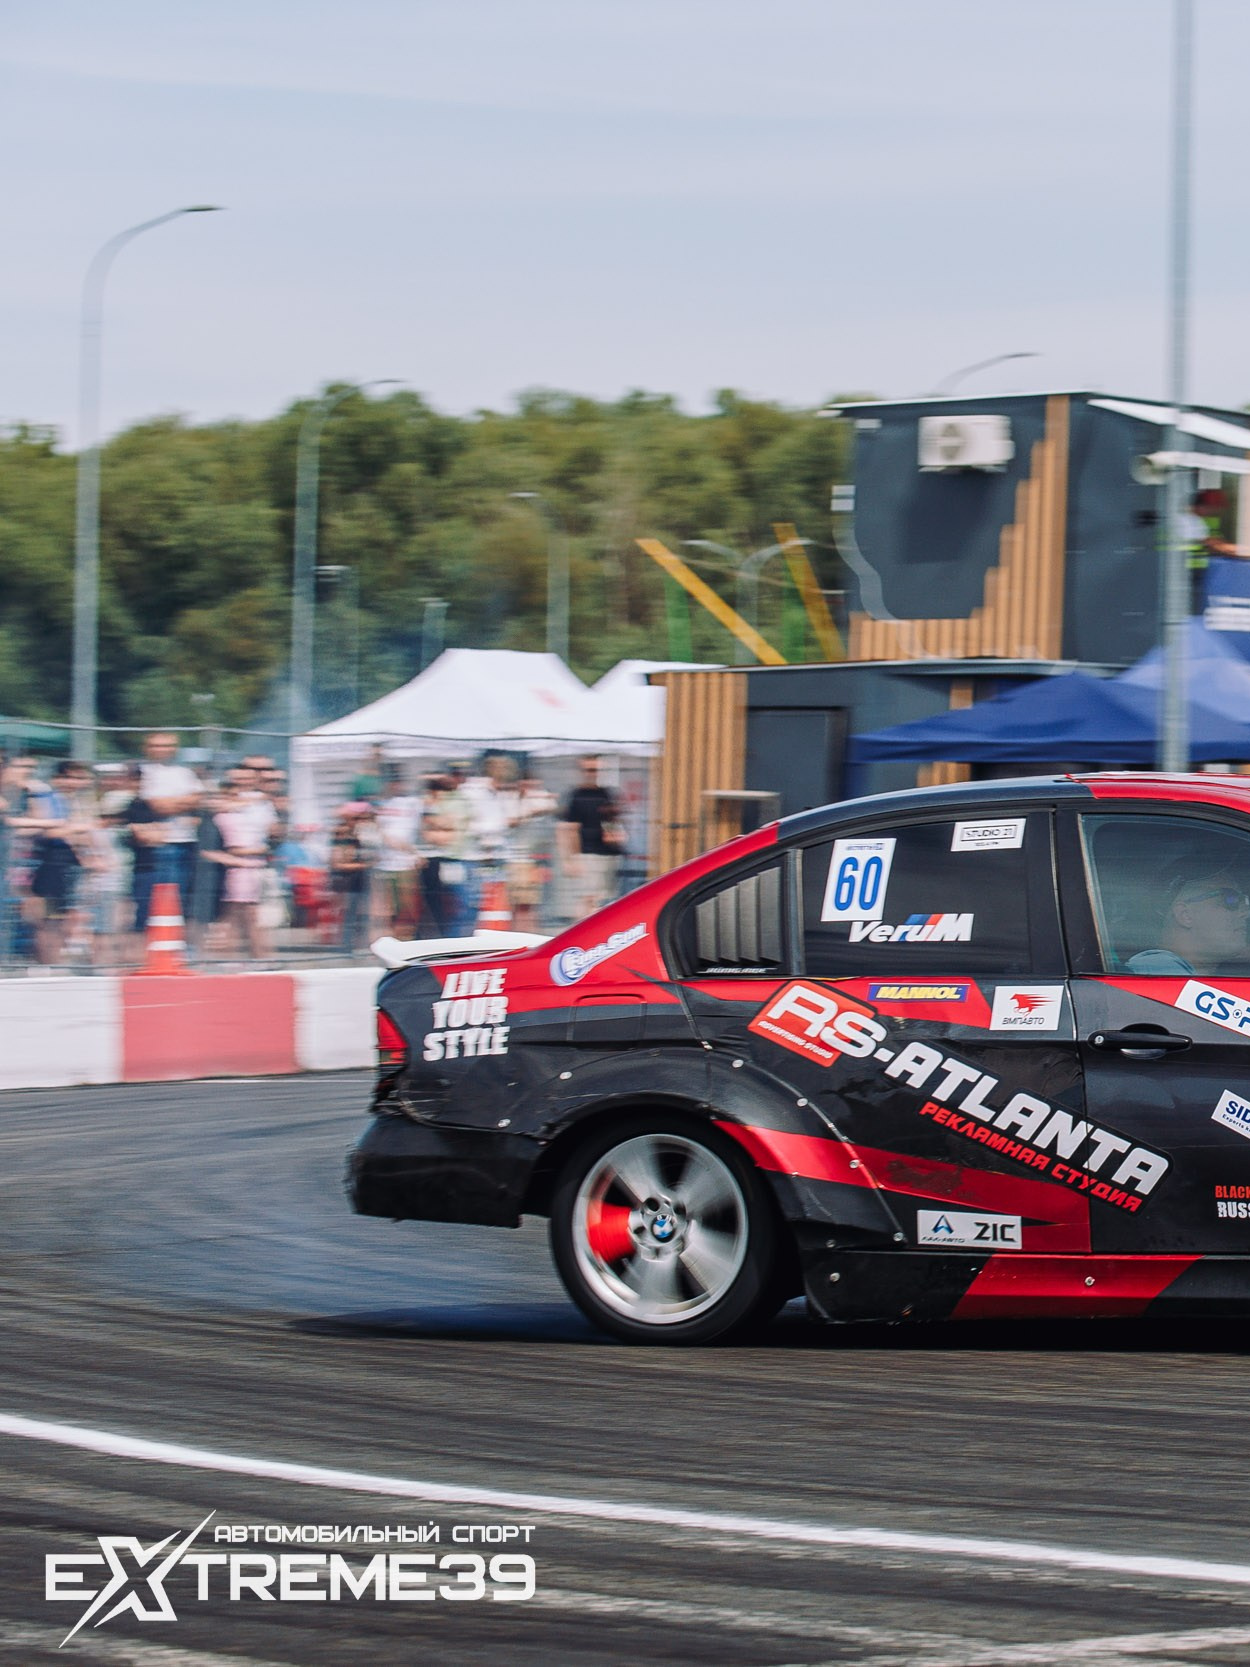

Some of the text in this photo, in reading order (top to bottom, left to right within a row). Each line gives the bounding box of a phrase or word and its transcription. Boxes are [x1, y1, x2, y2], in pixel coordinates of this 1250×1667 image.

[834, 856, 883, 911] 60
[440, 968, 508, 999] LIVE
[875, 986, 960, 1000] MANNOL
[431, 996, 509, 1030] YOUR
[1002, 1017, 1045, 1025] ВМПАВТО
[423, 1026, 510, 1062] STYLE
[757, 1020, 834, 1059] ADVERTISING STUDIO
[1222, 1114, 1245, 1129] Experts
[919, 1101, 1143, 1213] РЕКЛАМНАЯ СТУДИЯ
[974, 1222, 1016, 1242] ZIC
